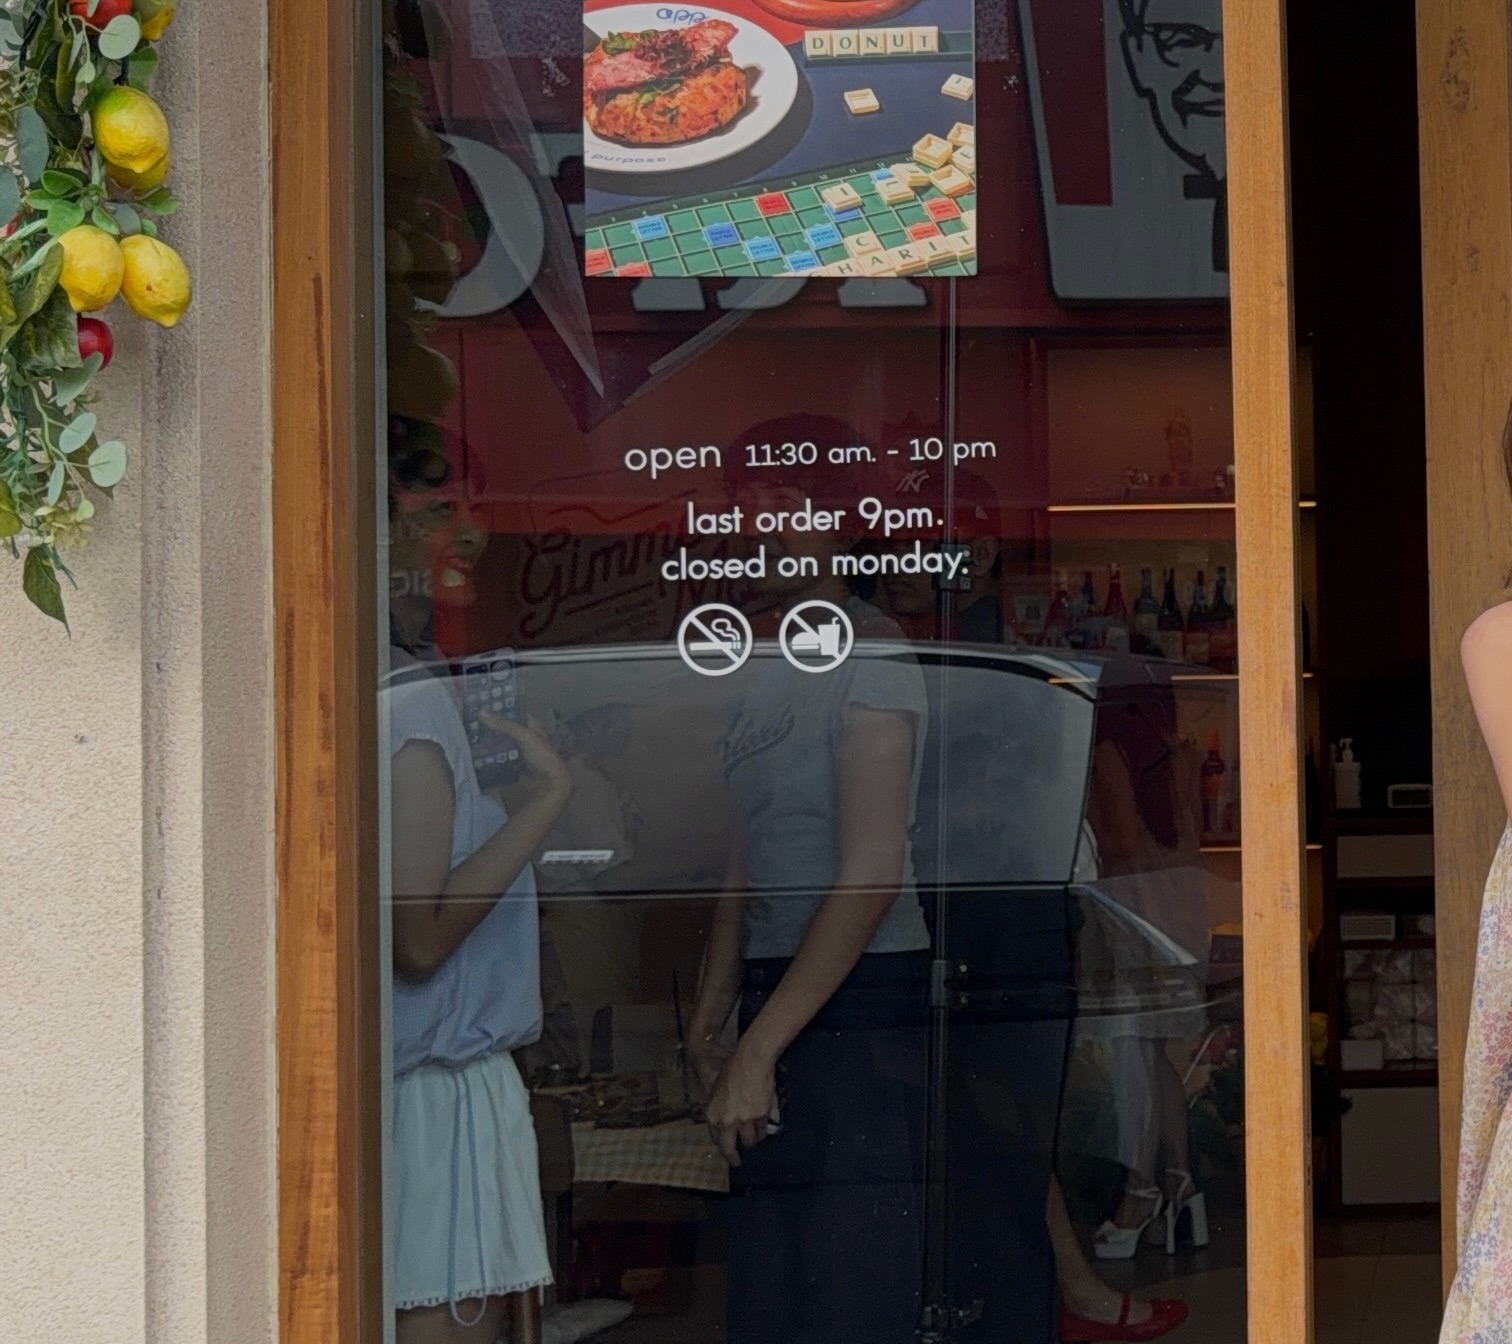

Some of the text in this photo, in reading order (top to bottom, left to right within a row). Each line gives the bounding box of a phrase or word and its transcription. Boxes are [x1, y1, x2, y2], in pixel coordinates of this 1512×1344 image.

[812, 34, 930, 50] DONUT
[591, 154, 667, 164] purpose
[624, 445, 721, 479] open
[745, 442, 818, 467] 11:30
[828, 446, 877, 464] am.
[909, 437, 943, 462] 10
[953, 439, 997, 466] pm
[687, 497, 945, 537] last order 9pm.
[661, 544, 766, 581] closed
[777, 555, 818, 577] on
